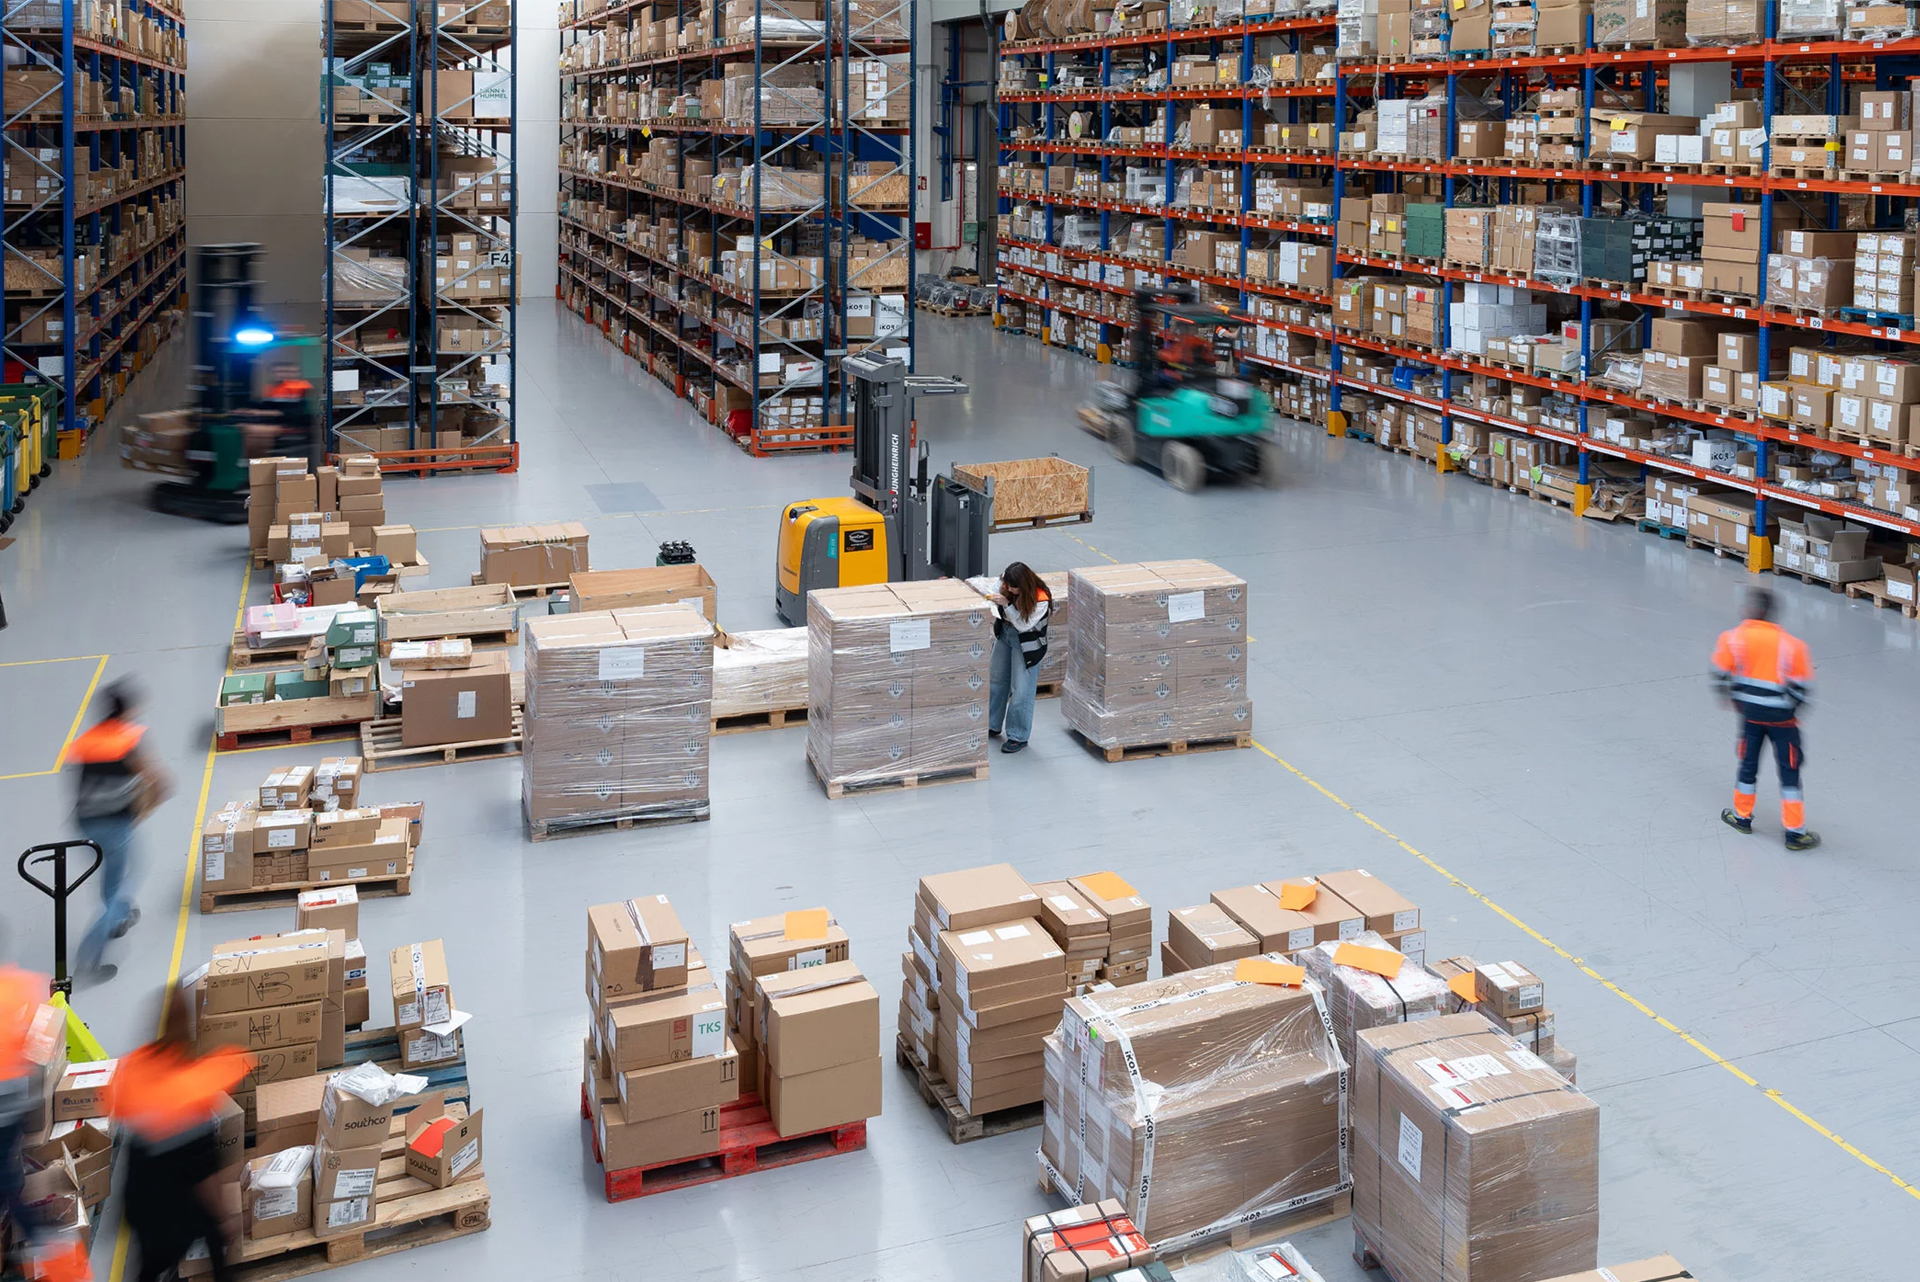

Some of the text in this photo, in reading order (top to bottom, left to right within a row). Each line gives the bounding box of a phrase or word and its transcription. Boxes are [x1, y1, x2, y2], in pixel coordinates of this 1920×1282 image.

[490, 253, 510, 265] F4
[1735, 311, 1743, 319] 10
[1812, 320, 1821, 328] 09
[1887, 328, 1897, 336] 08
[891, 433, 899, 495] JUNGHEINRICH
[698, 1021, 721, 1035] TKS
[344, 1116, 387, 1131] southco
[460, 1126, 468, 1138] B
[408, 1158, 439, 1176] southco
[464, 1214, 481, 1226] EPAL
